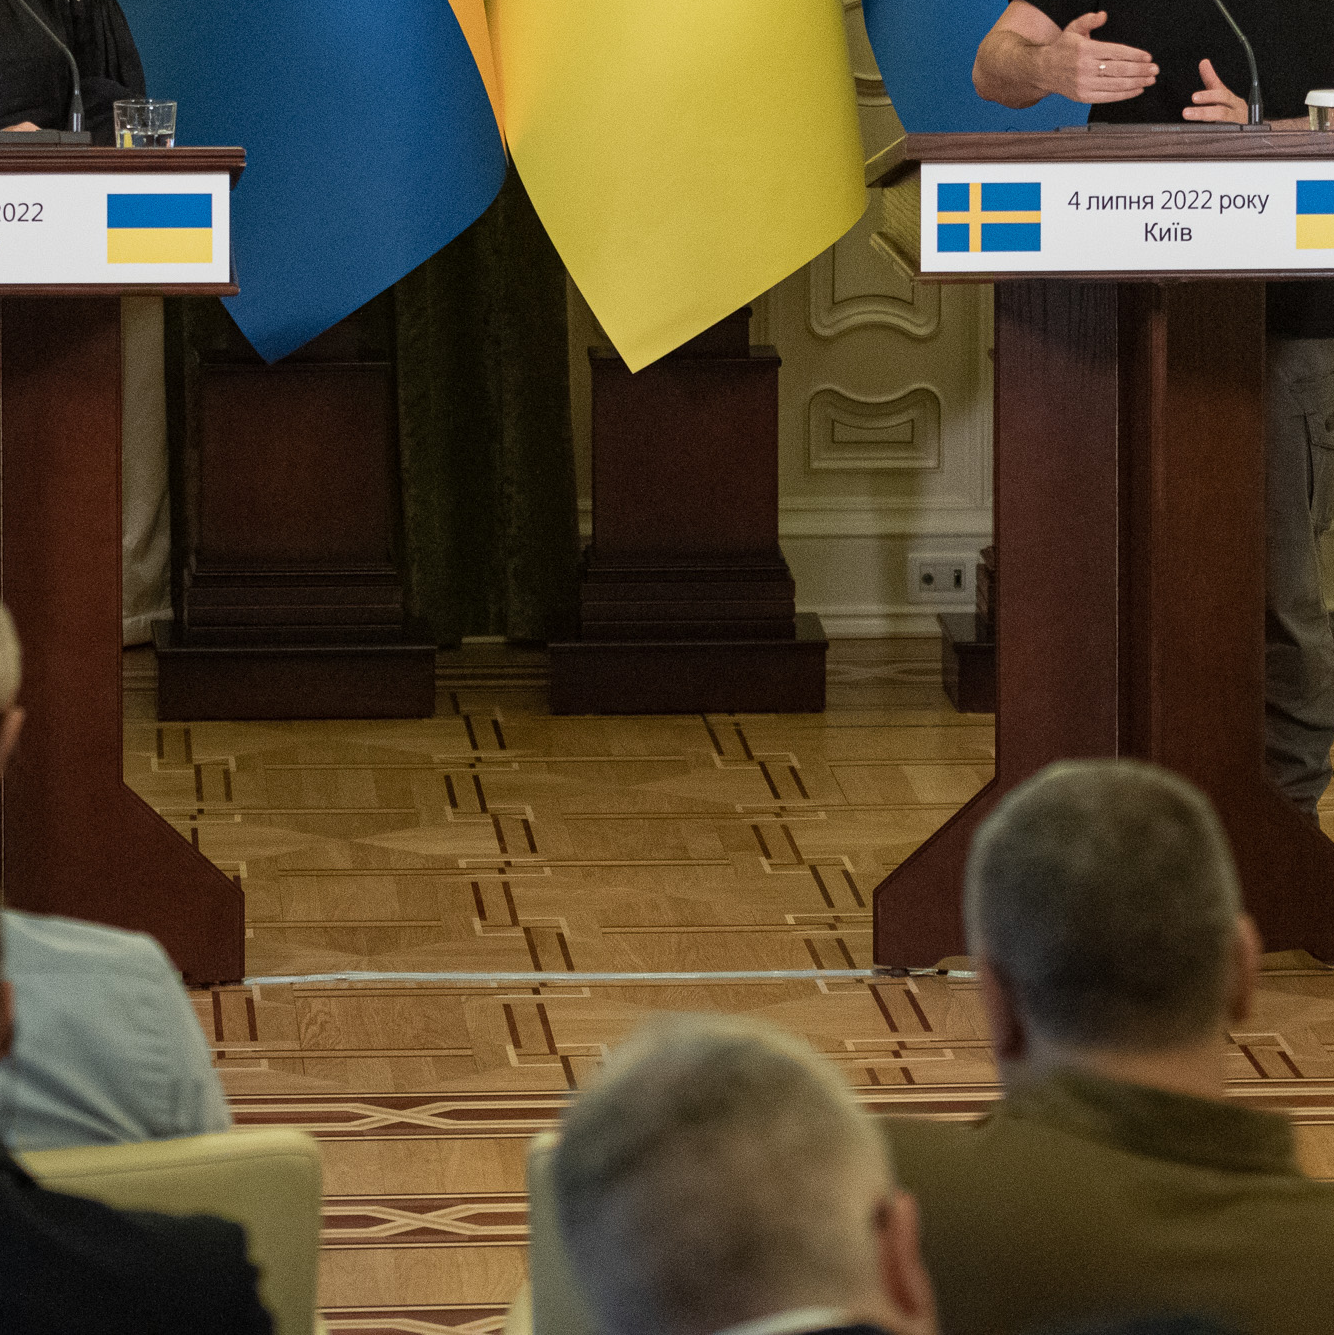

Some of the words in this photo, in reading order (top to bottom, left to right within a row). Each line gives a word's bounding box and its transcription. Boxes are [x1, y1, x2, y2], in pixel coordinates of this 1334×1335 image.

[1067, 190, 1081, 211] 4
[1086, 195, 1154, 211] липня
[1160, 189, 1213, 210] 2022
[1219, 194, 1270, 215] року
[1144, 222, 1193, 242] Київ
